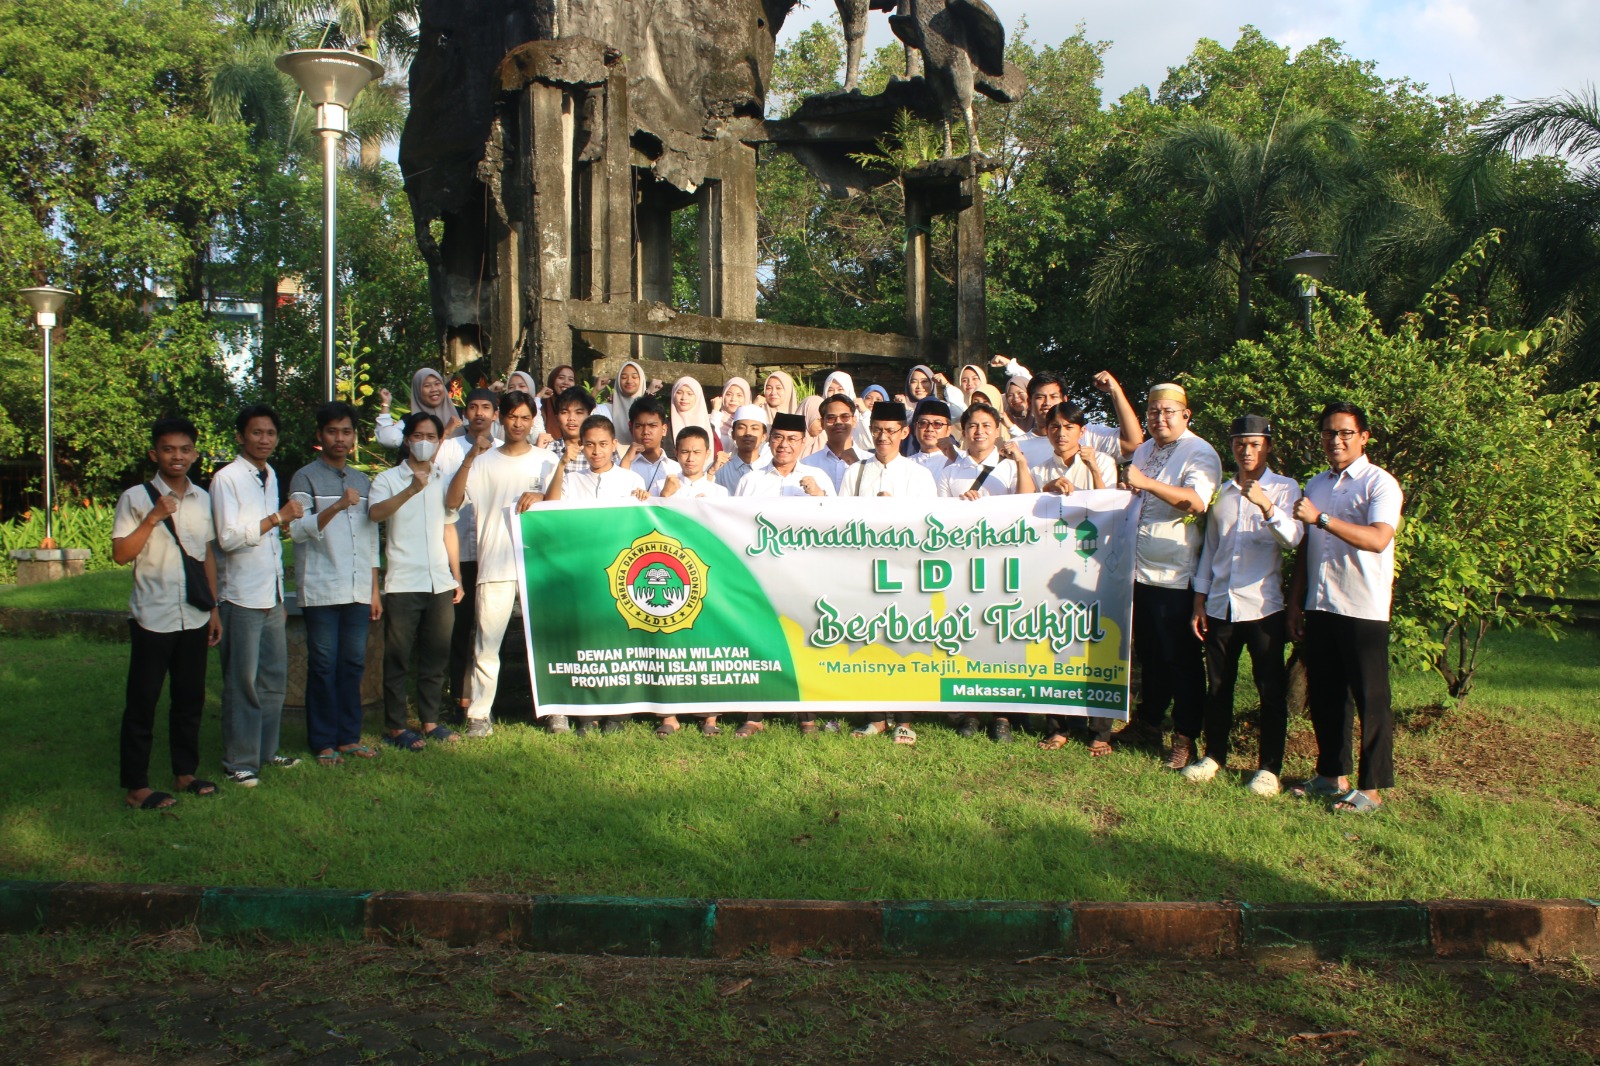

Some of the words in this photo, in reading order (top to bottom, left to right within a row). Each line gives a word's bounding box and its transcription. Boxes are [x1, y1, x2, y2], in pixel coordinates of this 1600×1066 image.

[746, 512, 920, 558] Ramadhan
[921, 512, 1040, 553] Berkah
[624, 544, 656, 567] DAKWAH
[660, 544, 685, 561] ISLAM
[618, 569, 634, 610] LEMBAGA
[685, 560, 699, 609] INDONESIA
[643, 615, 677, 625] LDII
[810, 594, 979, 655] Berbagi
[983, 597, 1105, 653] Takjil
[577, 648, 622, 661] DEWAN
[626, 647, 687, 660] PIMPINAN
[690, 647, 749, 659] WILAYAH
[548, 662, 608, 675] LEMBAGA
[611, 661, 664, 673] DAKWAH
[668, 661, 707, 672] ISLAM
[711, 660, 782, 672] INDONESIA
[911, 660, 960, 676] Takjil,
[966, 661, 1047, 677] Manisnya
[571, 674, 630, 687] PROVINSI
[634, 673, 697, 686] SULAWESI
[700, 673, 759, 685] SELATAN
[953, 684, 1026, 698] Makassar,
[1029, 685, 1035, 697] 1
[1040, 686, 1083, 700] Maret
[1086, 688, 1121, 703] 2026
